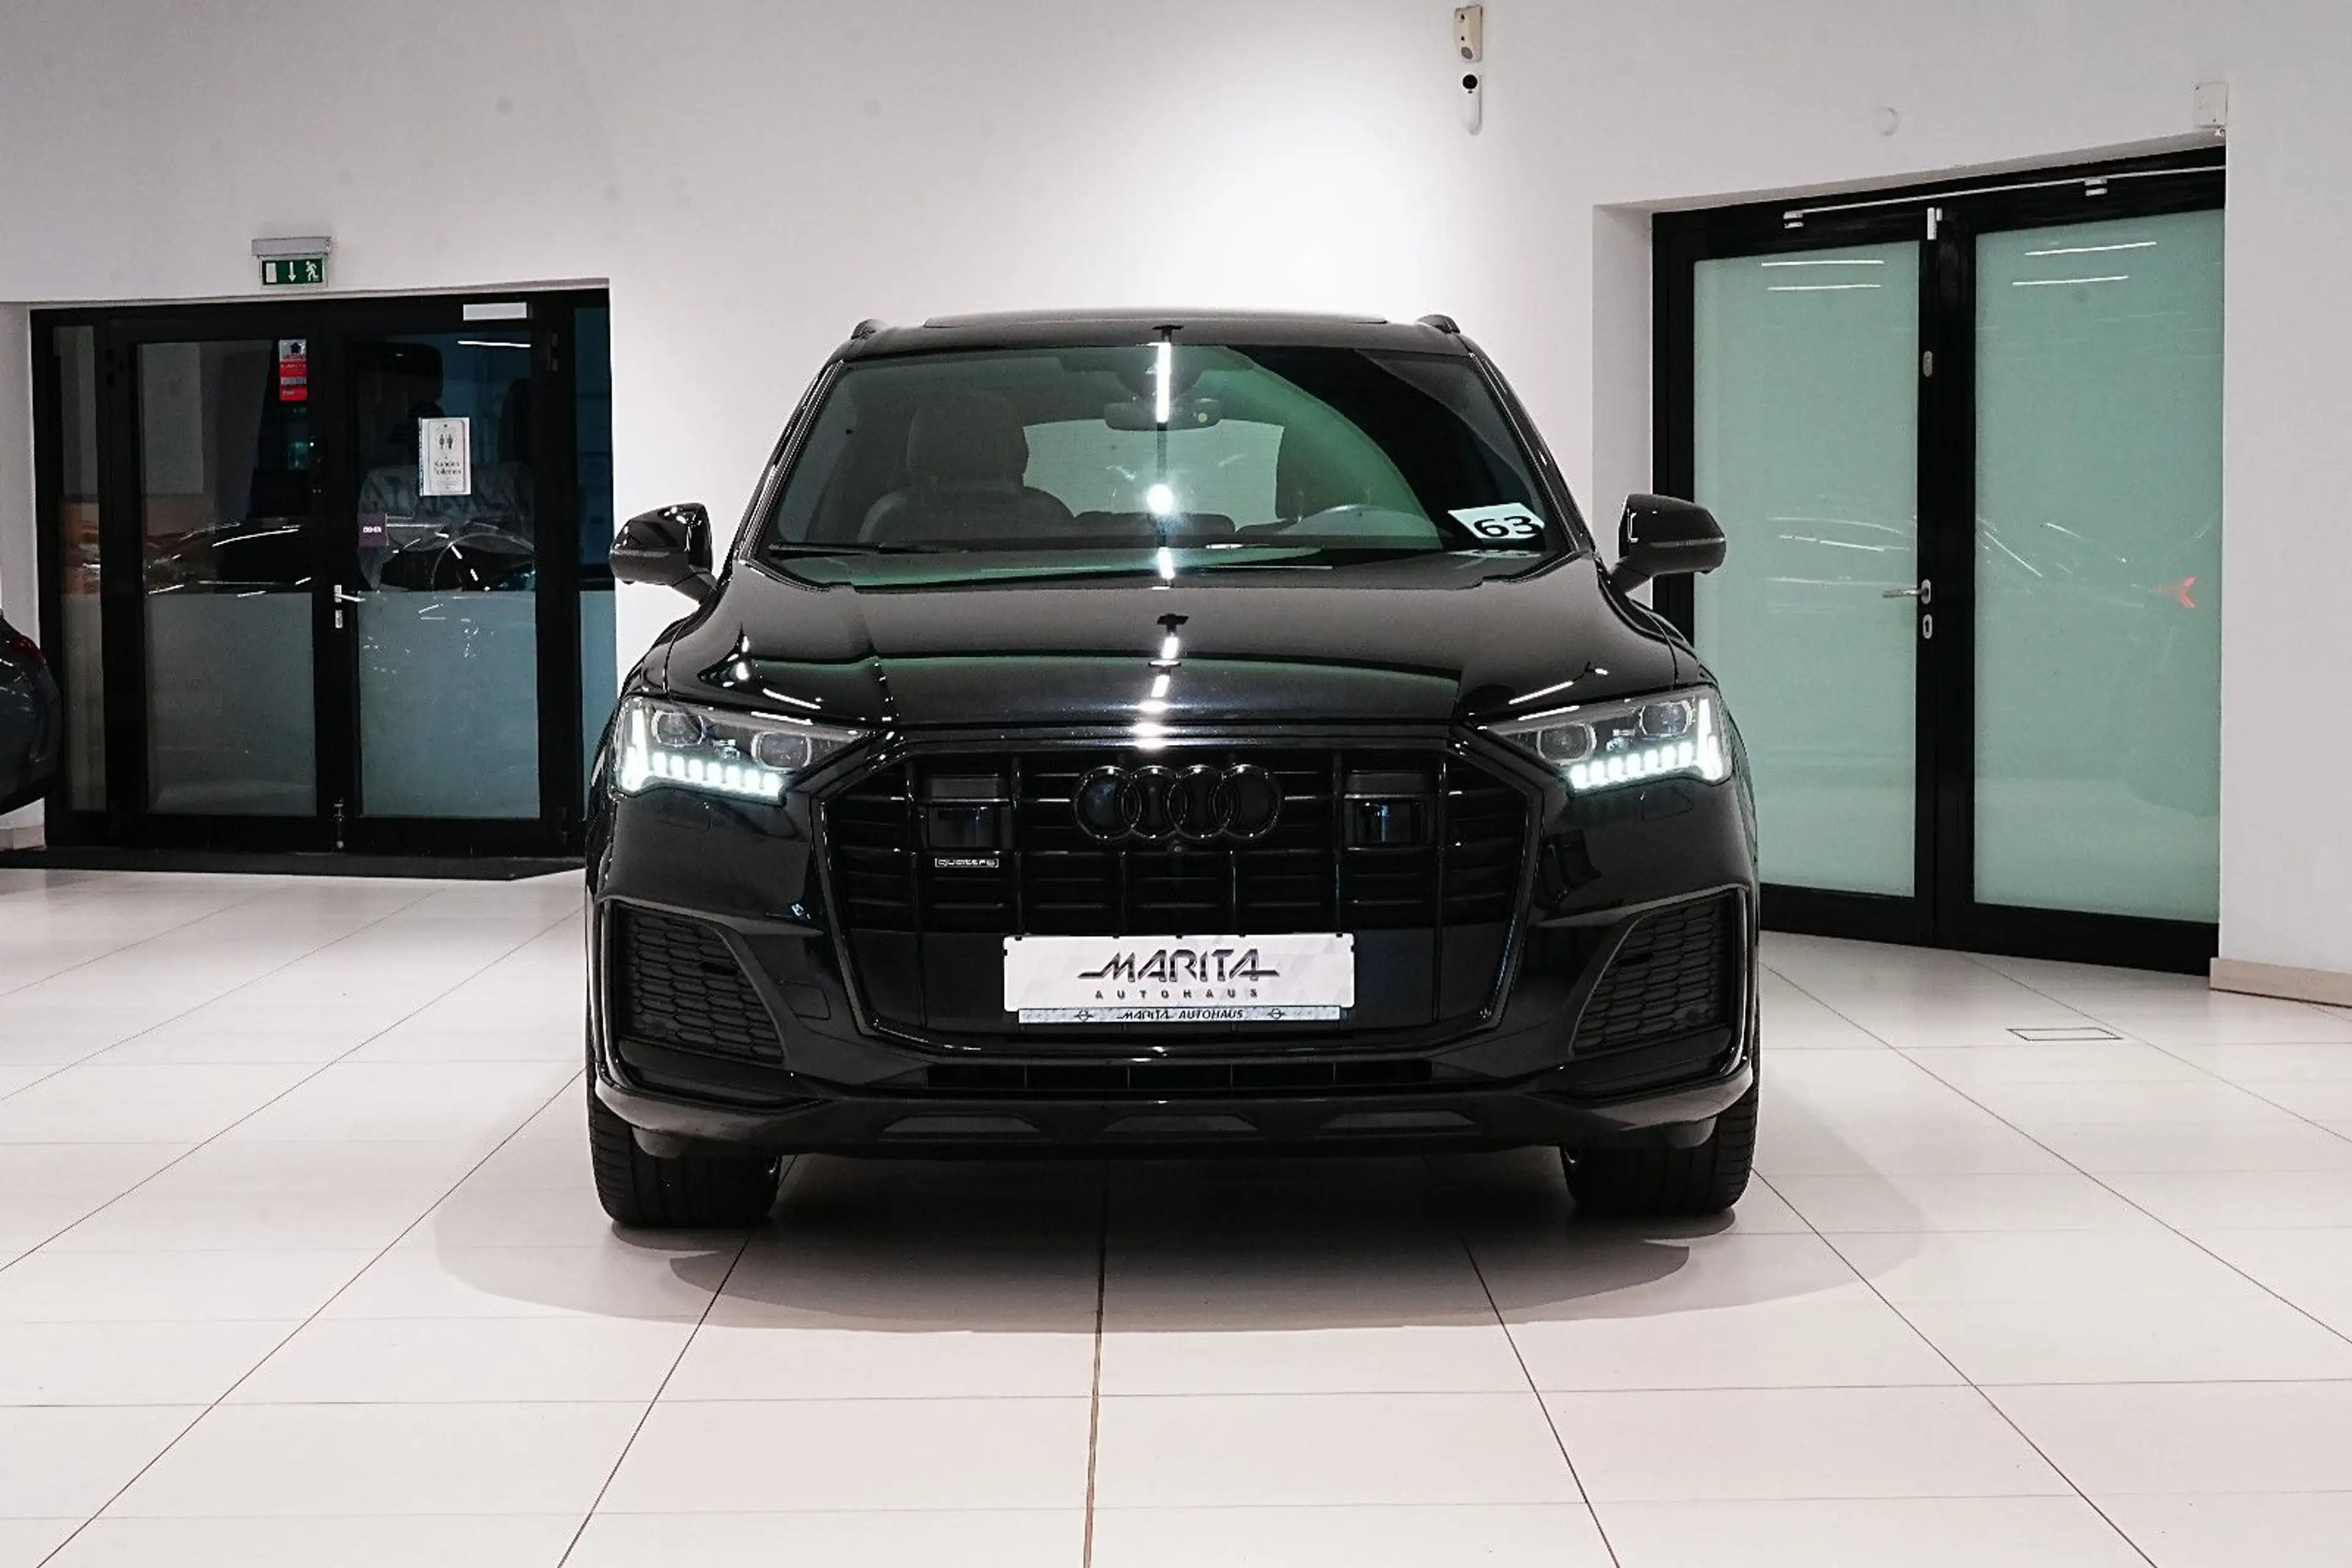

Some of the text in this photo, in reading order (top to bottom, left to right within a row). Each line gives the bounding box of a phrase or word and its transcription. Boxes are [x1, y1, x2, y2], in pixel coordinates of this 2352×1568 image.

[1473, 516, 1542, 537] 63
[1077, 948, 1280, 982] MARITA
[1095, 988, 1258, 1000] AUTOHAUS
[1116, 1009, 1243, 1020] MARITA AUTOHAUS
